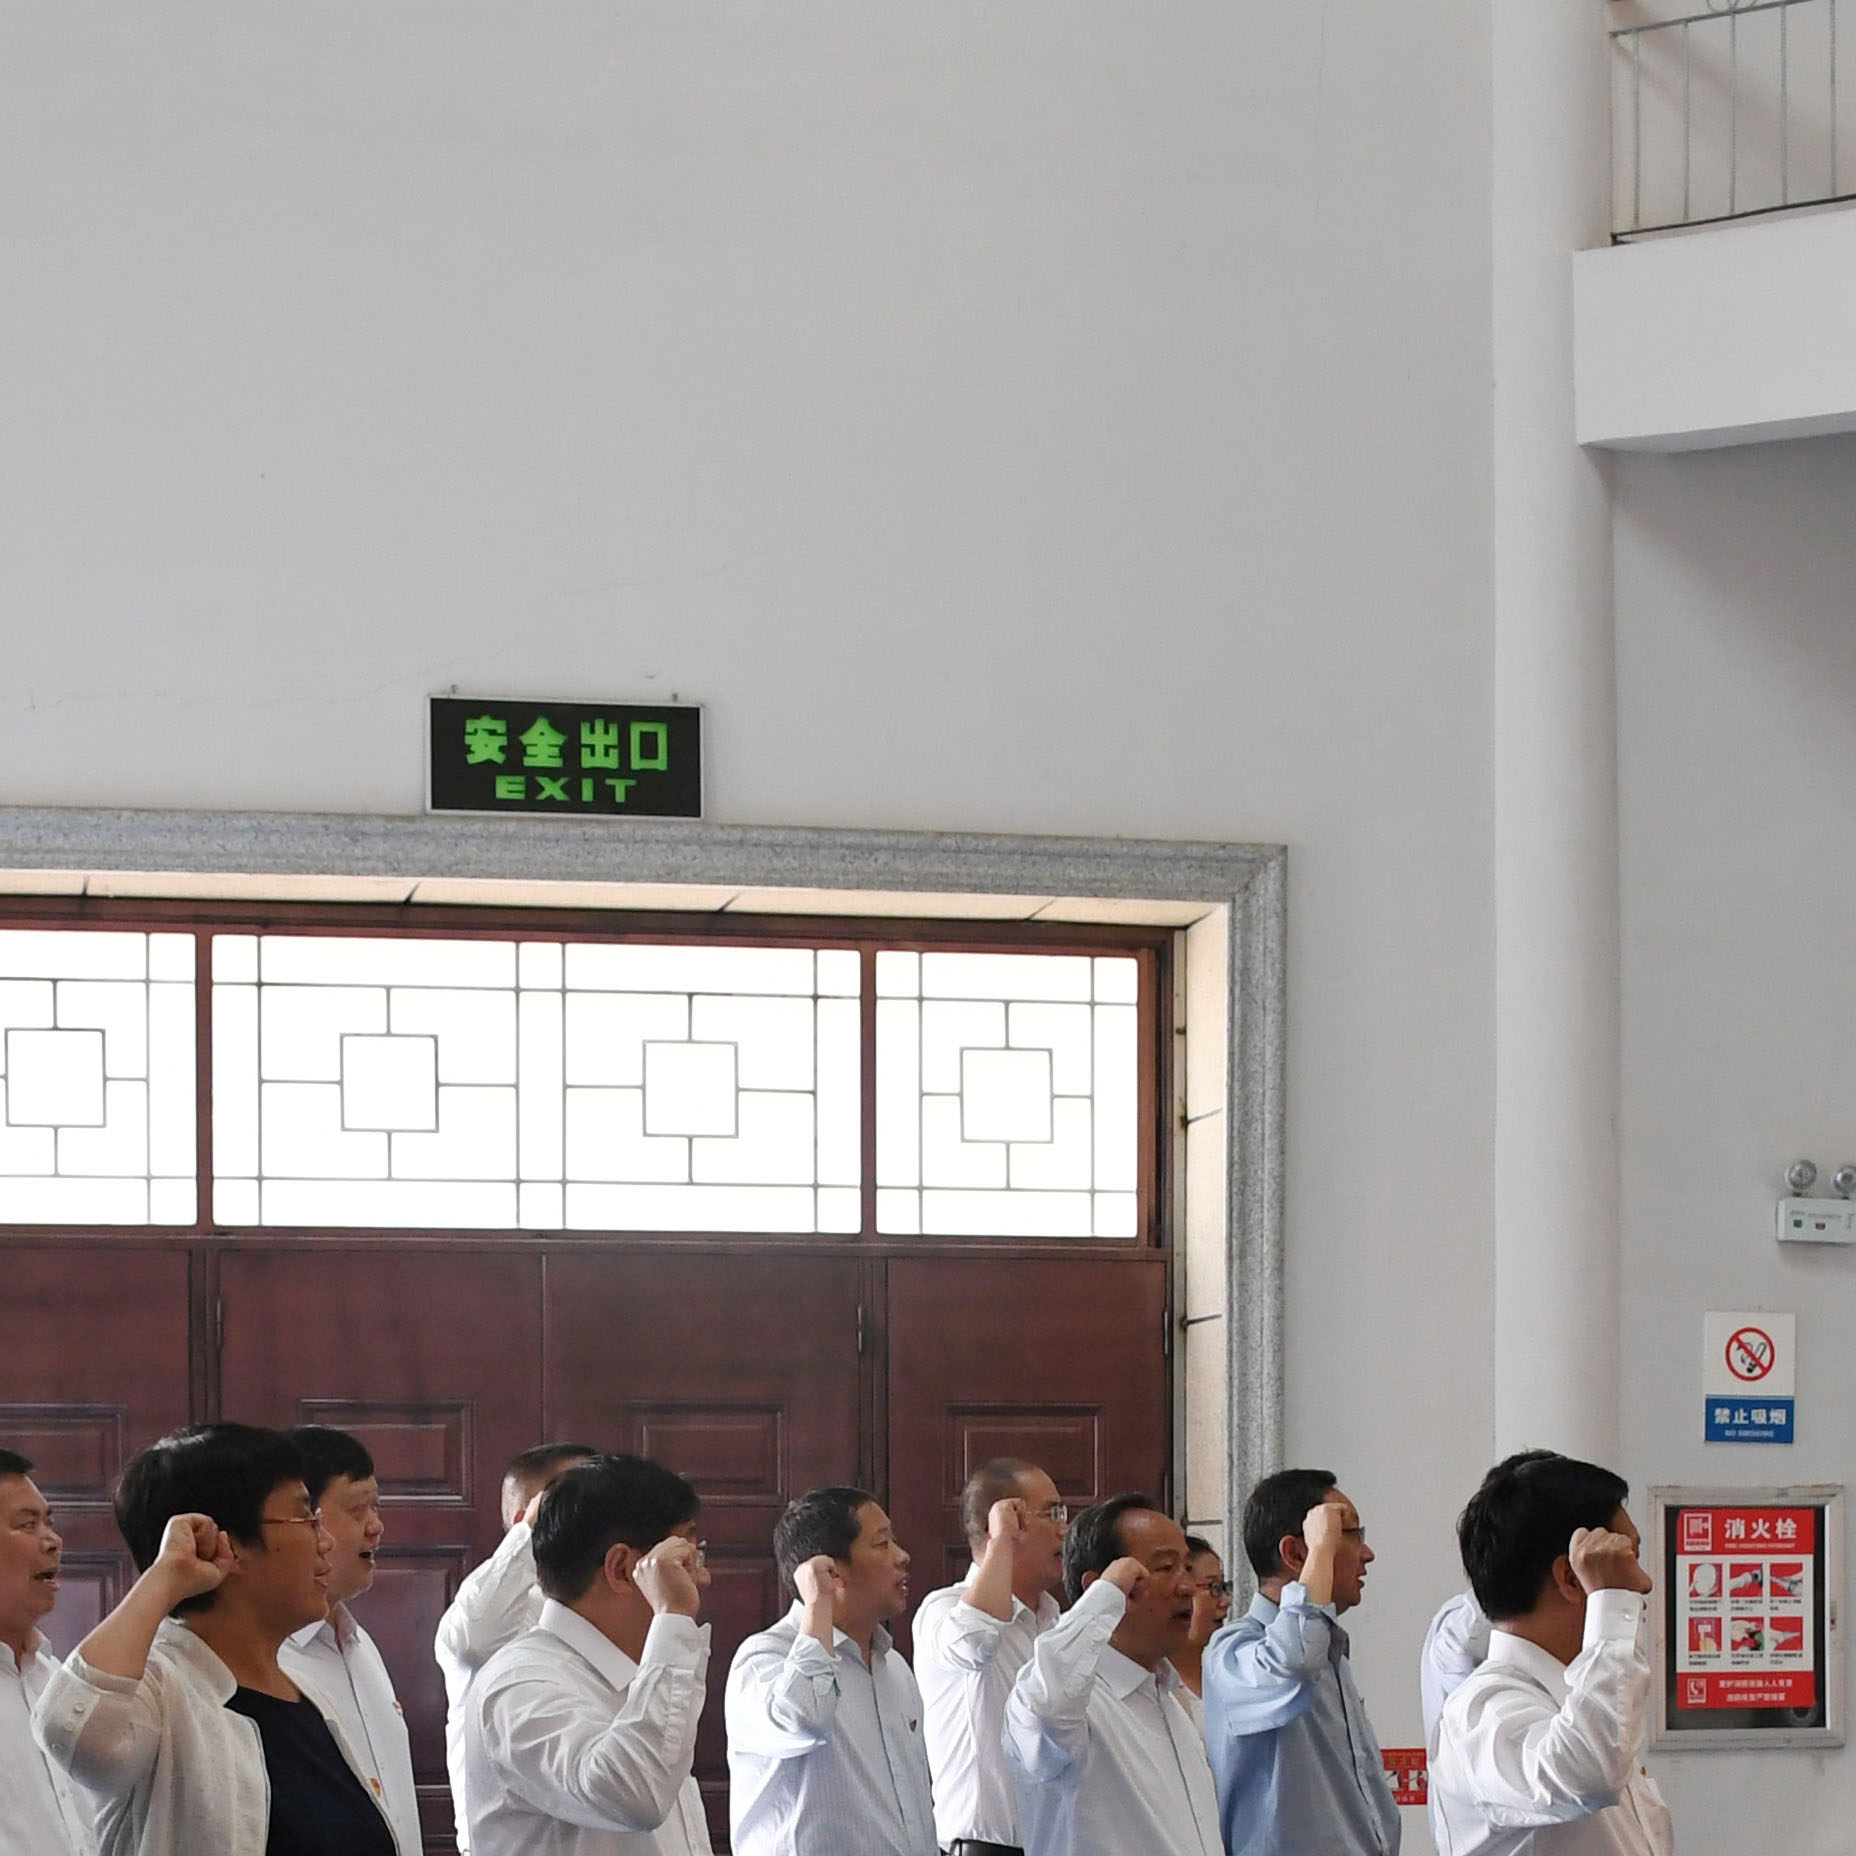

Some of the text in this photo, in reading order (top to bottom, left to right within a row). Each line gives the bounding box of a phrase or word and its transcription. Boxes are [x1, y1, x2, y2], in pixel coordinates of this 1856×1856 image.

[464, 714, 668, 771] 安全出口
[495, 775, 637, 803] EXIT
[1714, 1407, 1786, 1425] 禁止吸烟
[1724, 1517, 1798, 1540] 消火栓
